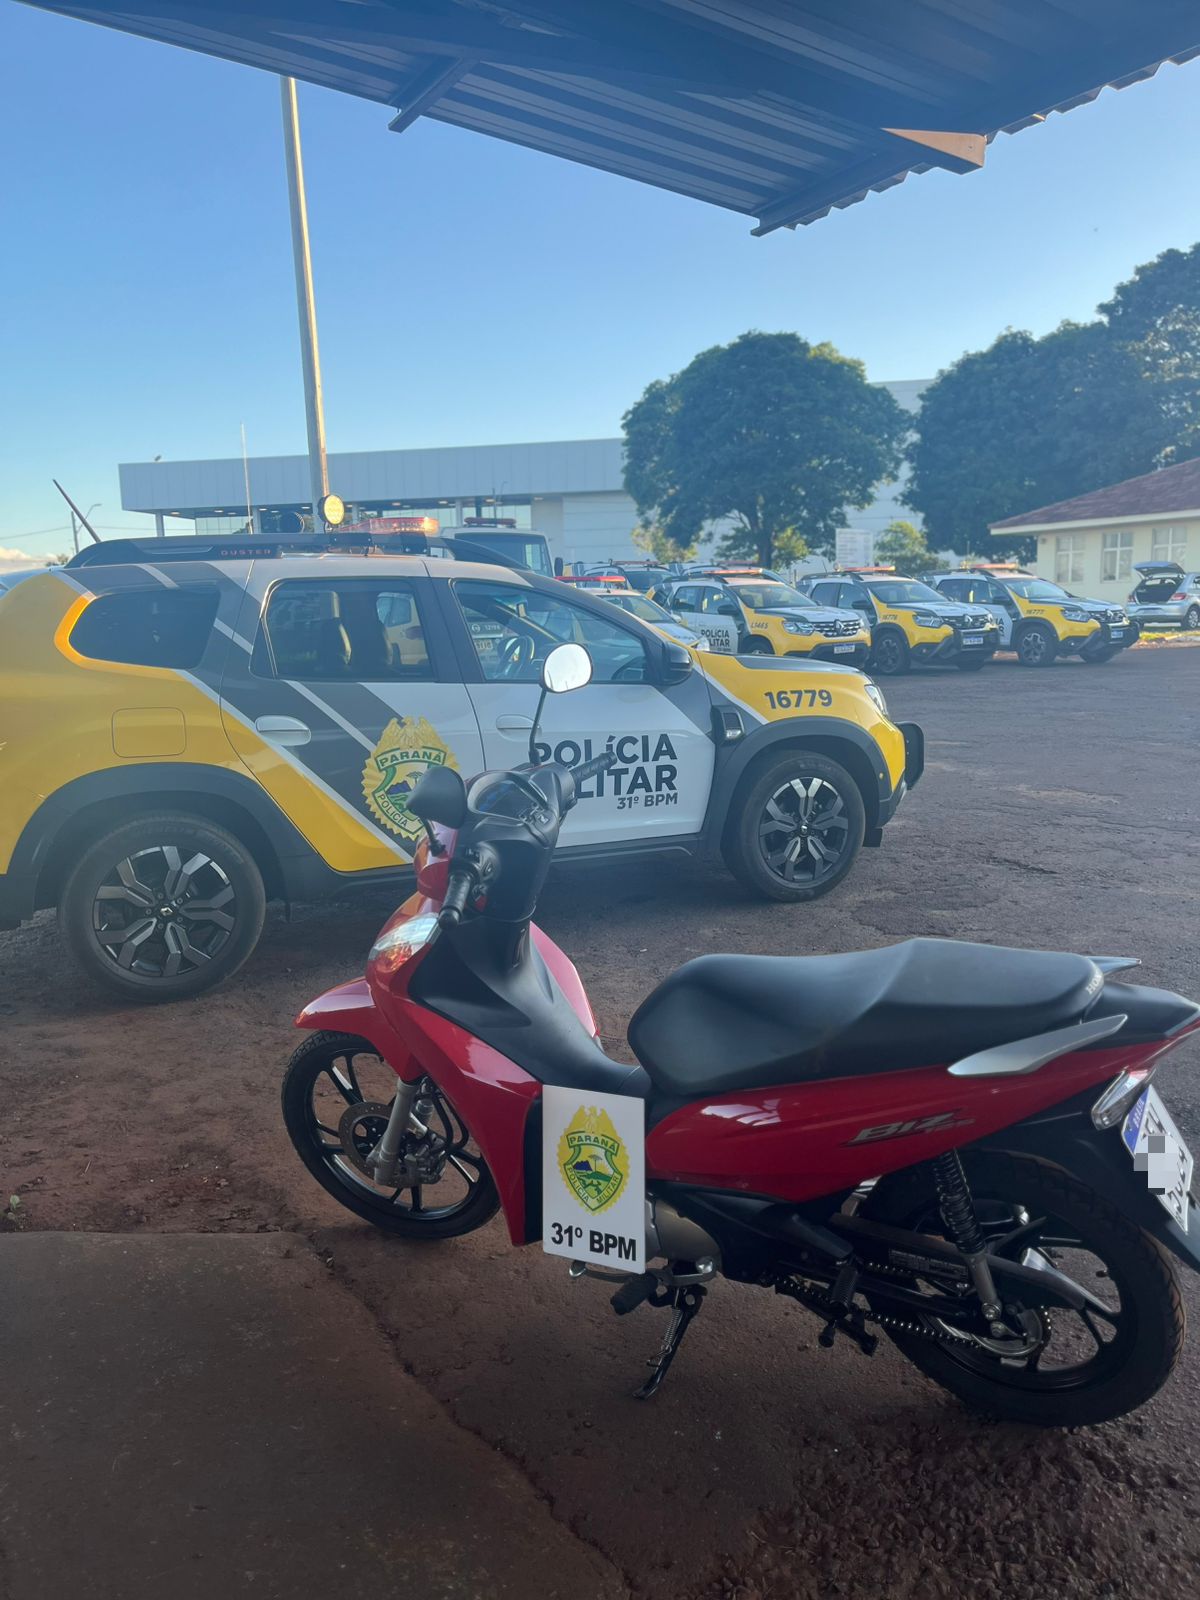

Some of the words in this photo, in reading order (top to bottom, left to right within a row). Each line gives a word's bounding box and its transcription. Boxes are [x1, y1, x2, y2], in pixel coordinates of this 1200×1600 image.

[764, 690, 833, 710] 16779
[379, 750, 442, 767] PARANÁ
[644, 792, 679, 807] BPM
[847, 1111, 956, 1146] BIZ
[569, 1134, 617, 1152] PARANÁ
[596, 1175, 620, 1204] MILITAR
[551, 1222, 583, 1248] 31º
[589, 1230, 637, 1262] BPM
